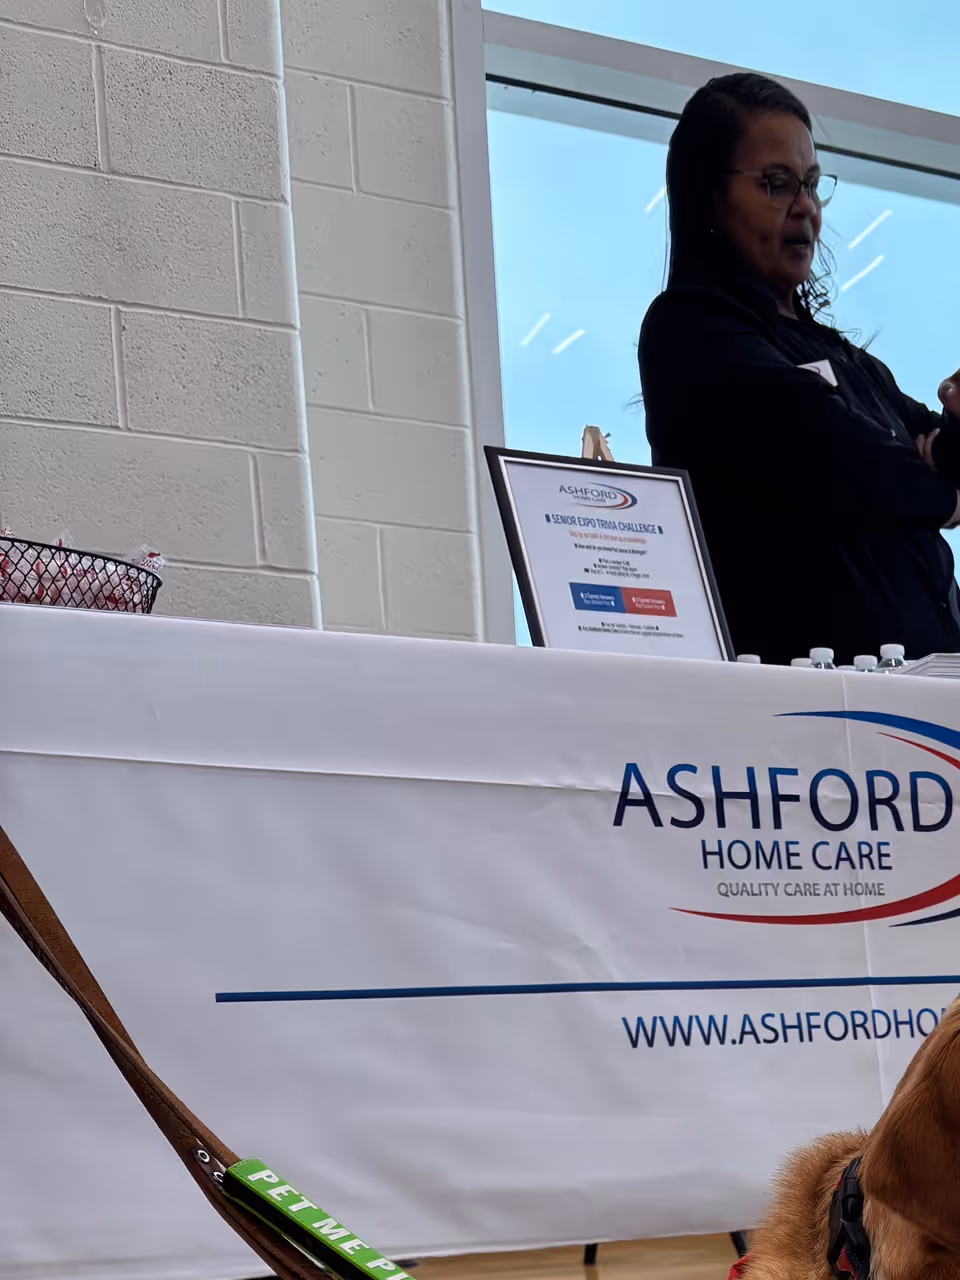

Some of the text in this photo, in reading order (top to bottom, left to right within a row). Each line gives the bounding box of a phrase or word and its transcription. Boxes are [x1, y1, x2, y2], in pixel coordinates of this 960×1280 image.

[559, 484, 617, 500] ASHFORD
[551, 513, 657, 535] SENIOR EXPO TRIVIA CHALLENGE
[613, 762, 954, 832] ASHFORD
[701, 839, 893, 871] HOME CARE
[717, 882, 885, 897] QUALITY CARE AT HOME
[622, 1007, 950, 1049] WWW.ASHFORDHO
[247, 1169, 317, 1213] PET
[312, 1217, 370, 1255] ME
